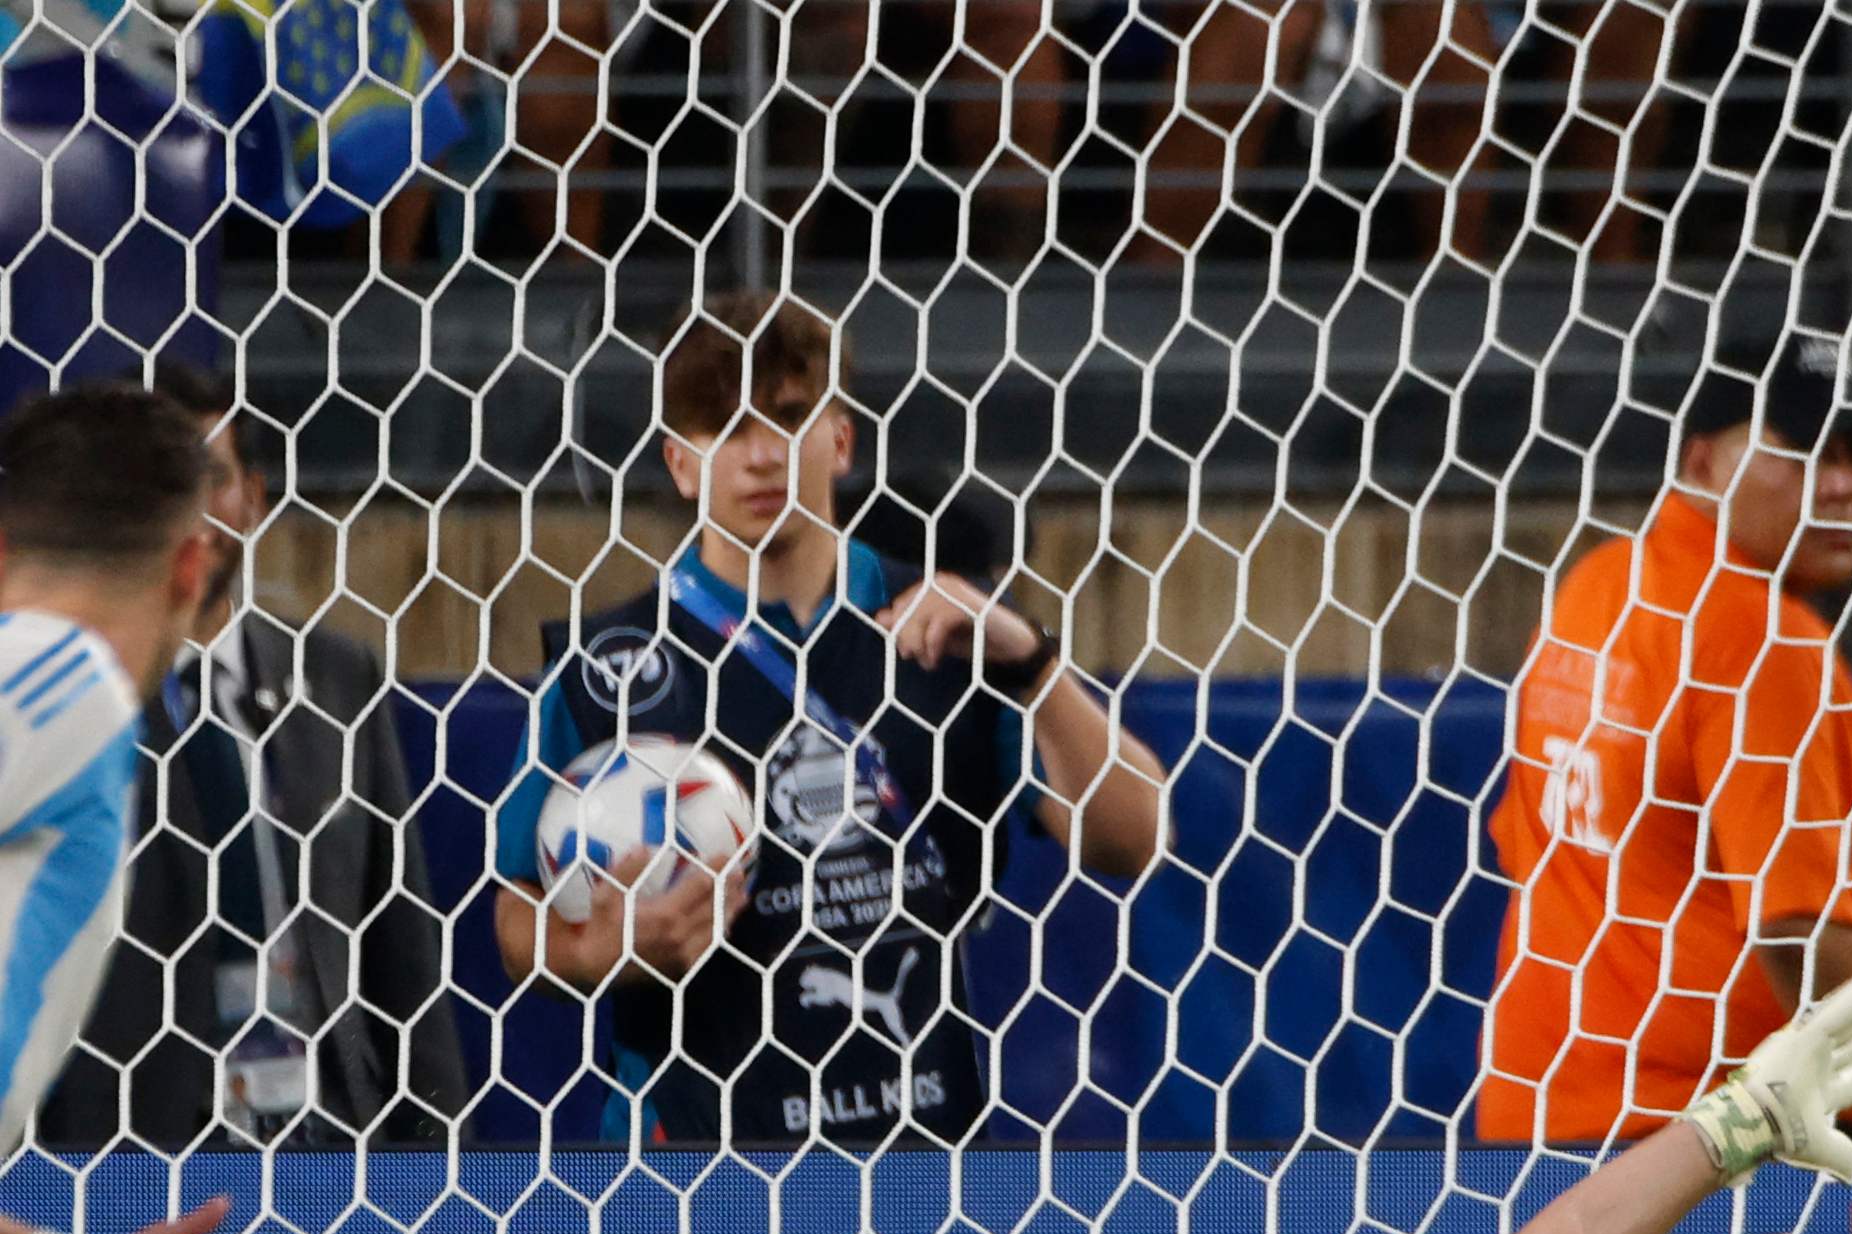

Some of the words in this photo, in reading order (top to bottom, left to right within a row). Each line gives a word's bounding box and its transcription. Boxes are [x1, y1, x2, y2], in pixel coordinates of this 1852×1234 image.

[829, 863, 929, 902] AMERCA
[808, 904, 849, 929] SA
[782, 1085, 878, 1132] BALL
[879, 1070, 946, 1115] KDS
